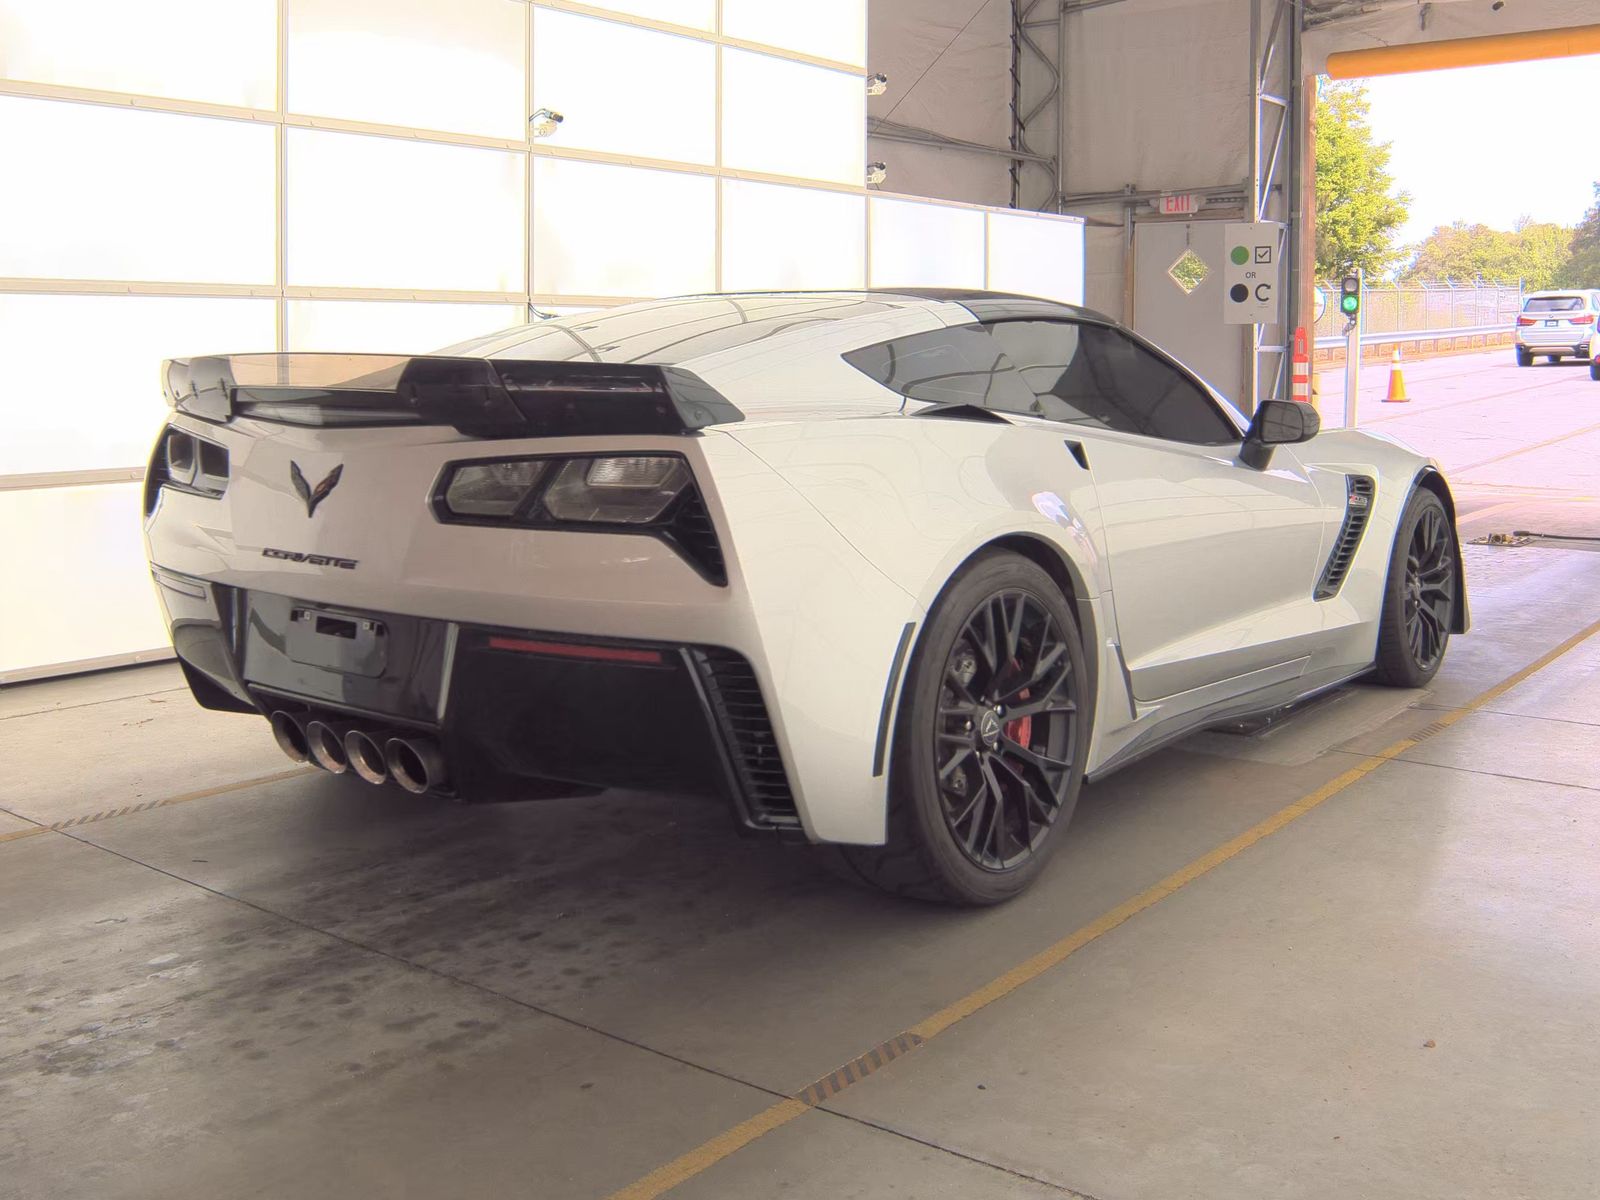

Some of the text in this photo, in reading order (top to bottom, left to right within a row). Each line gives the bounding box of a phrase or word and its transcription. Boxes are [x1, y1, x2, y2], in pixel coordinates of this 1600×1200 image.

[1166, 195, 1190, 211] EXIT
[1245, 271, 1256, 279] OR
[262, 547, 358, 569] CORVETTE
